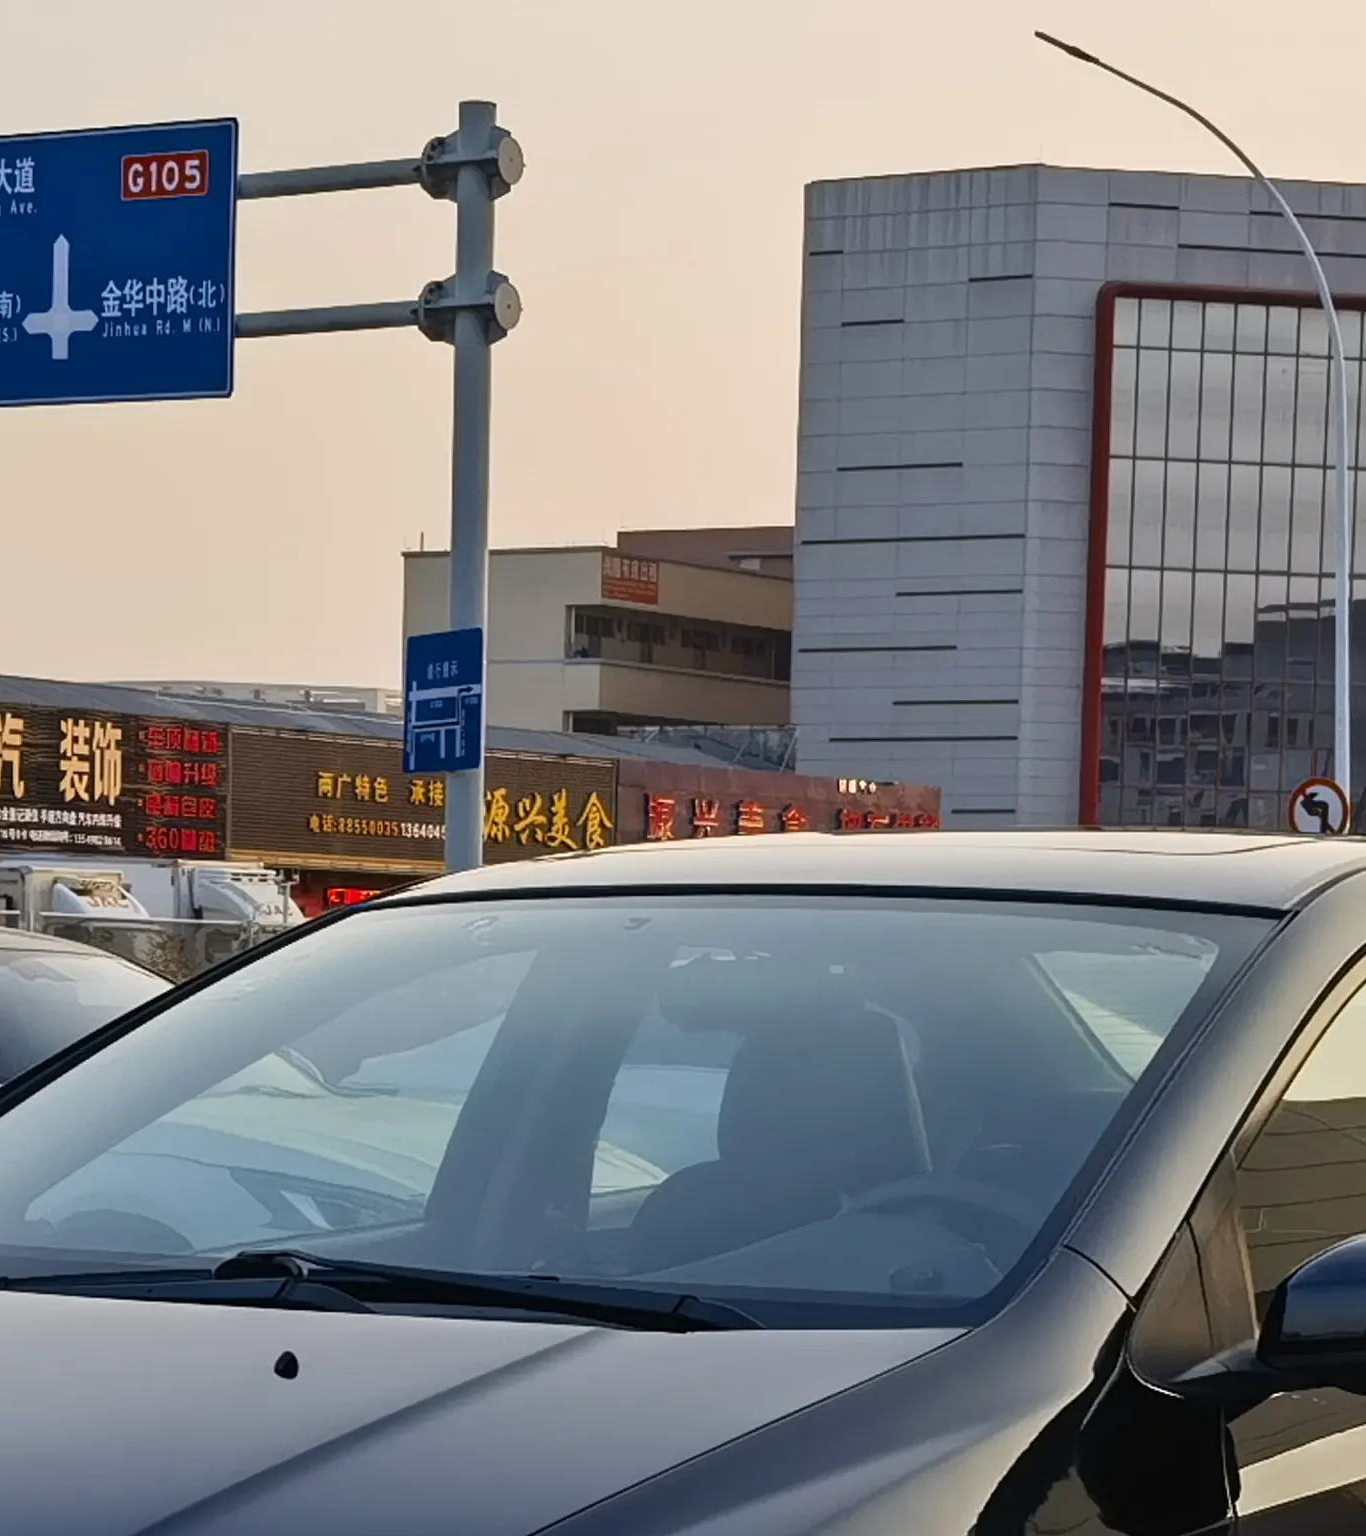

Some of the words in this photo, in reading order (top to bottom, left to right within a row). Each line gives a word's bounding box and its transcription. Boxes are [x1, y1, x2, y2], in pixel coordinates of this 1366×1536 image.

[128, 159, 201, 193] G105
[10, 199, 37, 215] Ave.
[100, 276, 225, 317] 金华中路(北)
[102, 321, 147, 337] Jinhua
[156, 319, 175, 335] Rd.
[59, 718, 122, 806] 装饰
[317, 771, 389, 802] 两广特色
[410, 779, 445, 806] 承接
